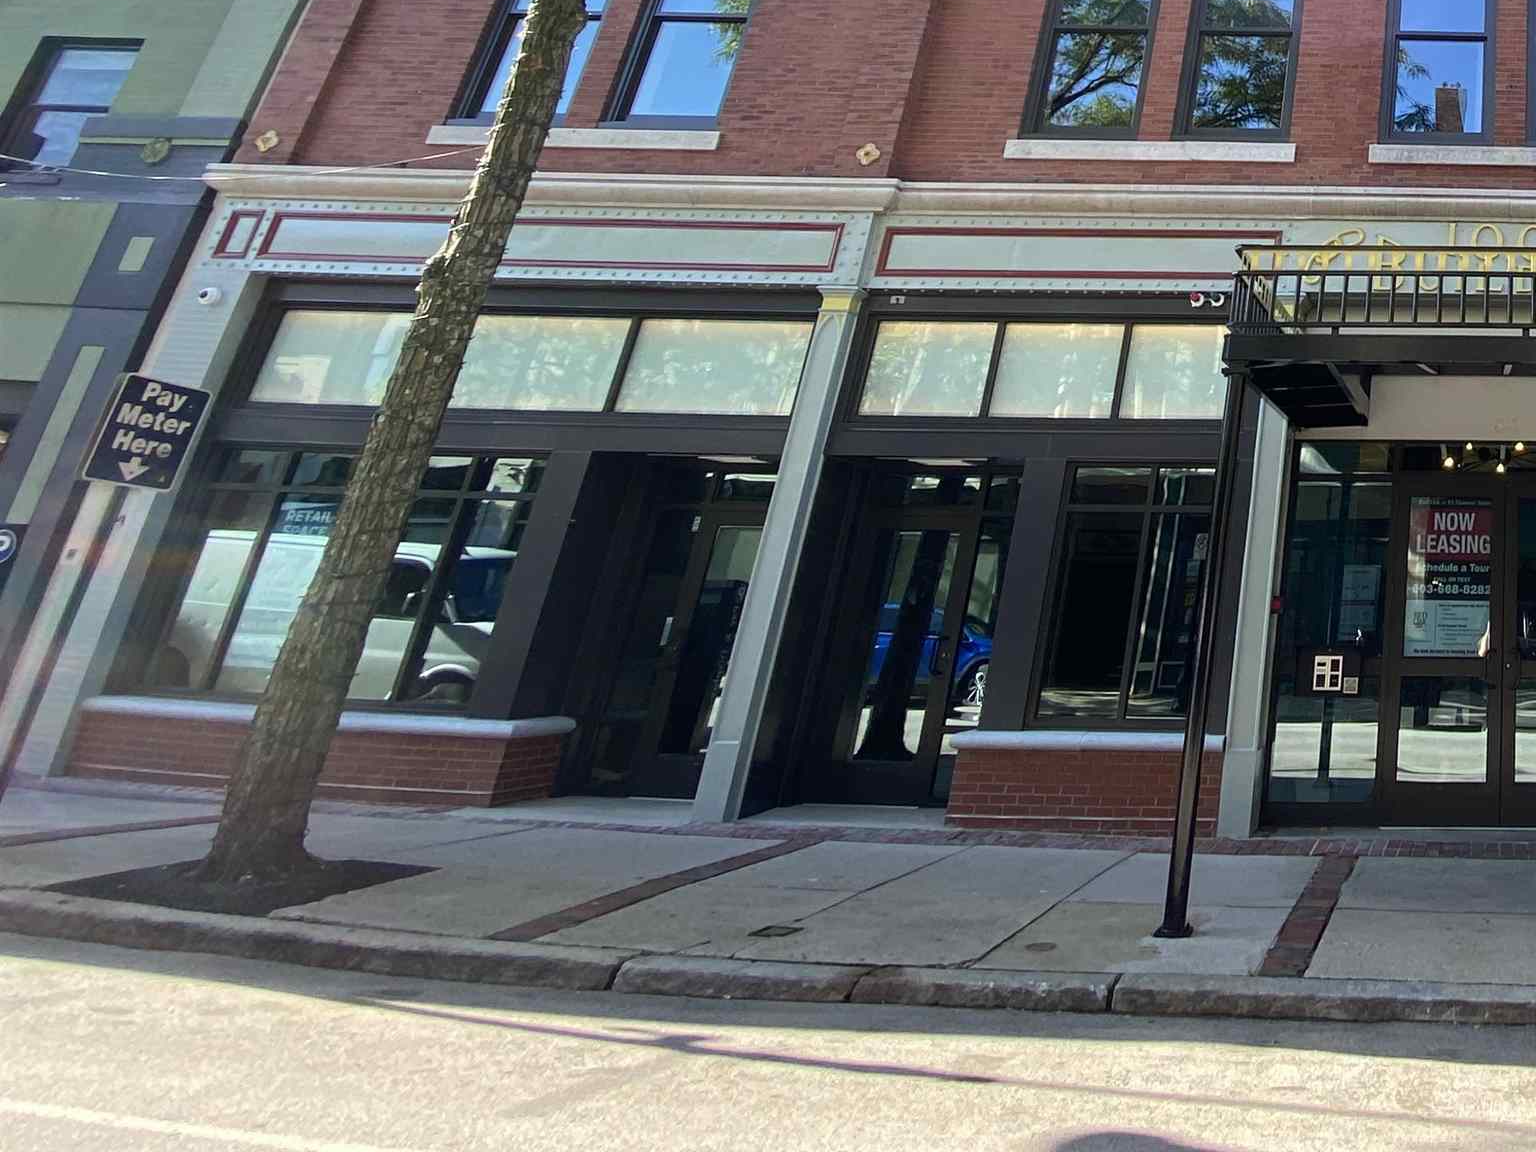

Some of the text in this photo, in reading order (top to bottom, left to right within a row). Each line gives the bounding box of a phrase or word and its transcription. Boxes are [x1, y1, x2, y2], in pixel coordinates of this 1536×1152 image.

[140, 381, 189, 413] Pay
[115, 402, 192, 436] Meter
[111, 428, 173, 459] Here
[285, 510, 332, 524] RETAIL
[1433, 512, 1476, 531] NOW
[1415, 534, 1491, 554] LEASING
[1469, 563, 1490, 573] Tour
